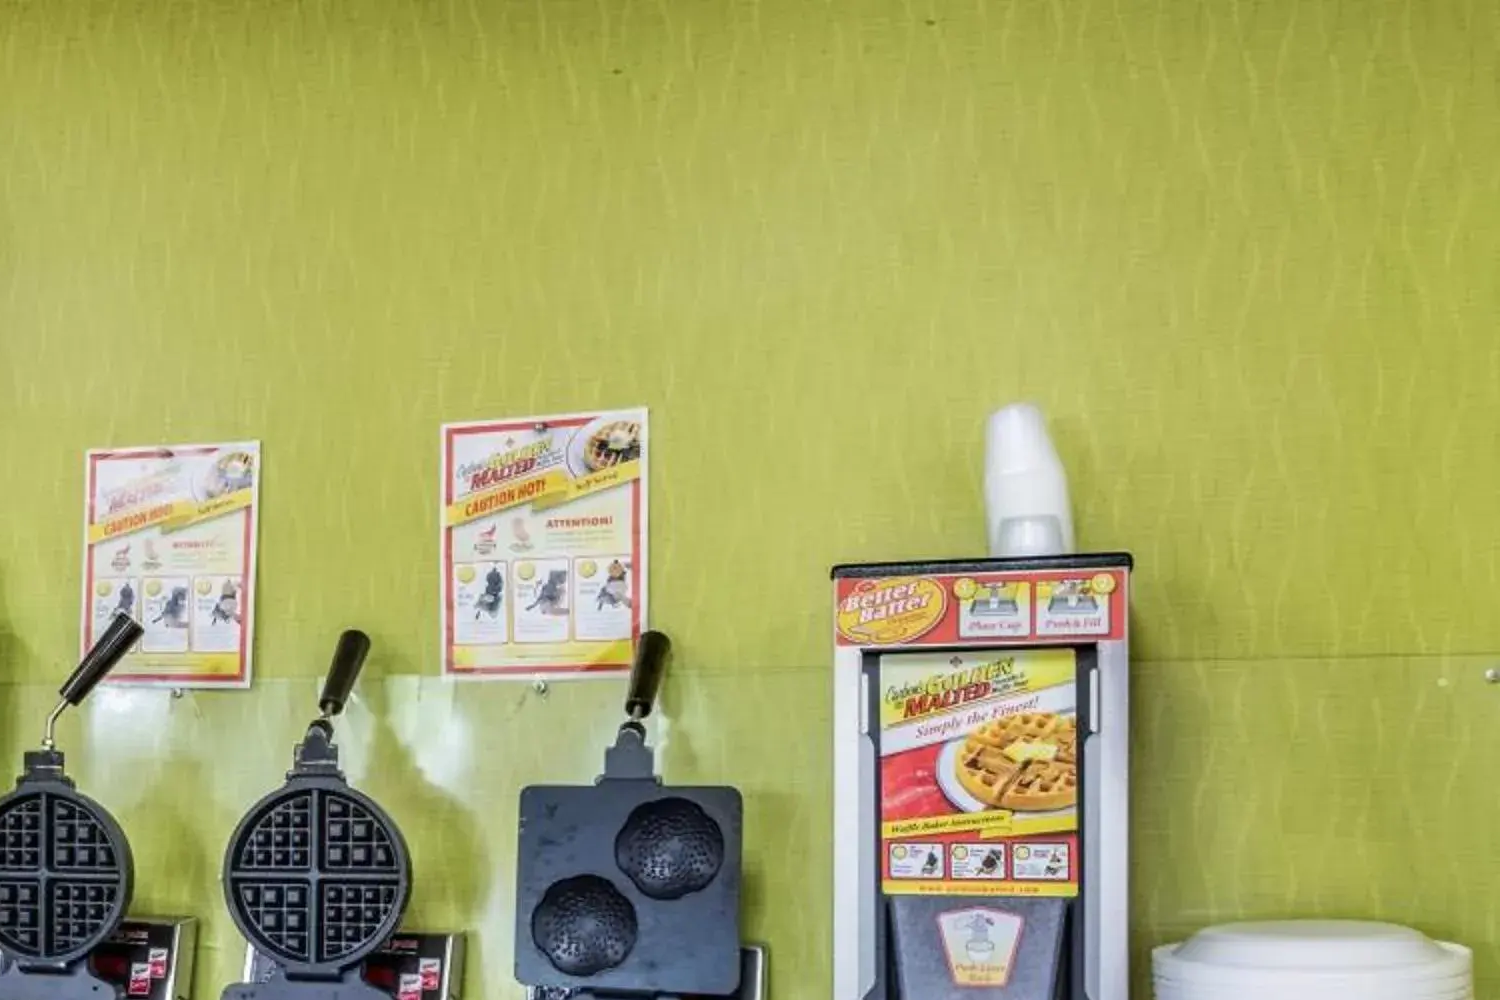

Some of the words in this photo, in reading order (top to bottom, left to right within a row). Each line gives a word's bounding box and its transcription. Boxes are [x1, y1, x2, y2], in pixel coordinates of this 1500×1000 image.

[465, 488, 515, 517] CAUTION
[545, 515, 614, 529] ATTENTION!
[844, 581, 918, 613] Better
[903, 680, 993, 718] MALTED
[915, 718, 962, 740] Simply
[966, 709, 989, 726] the
[991, 695, 1040, 718] Finest!
